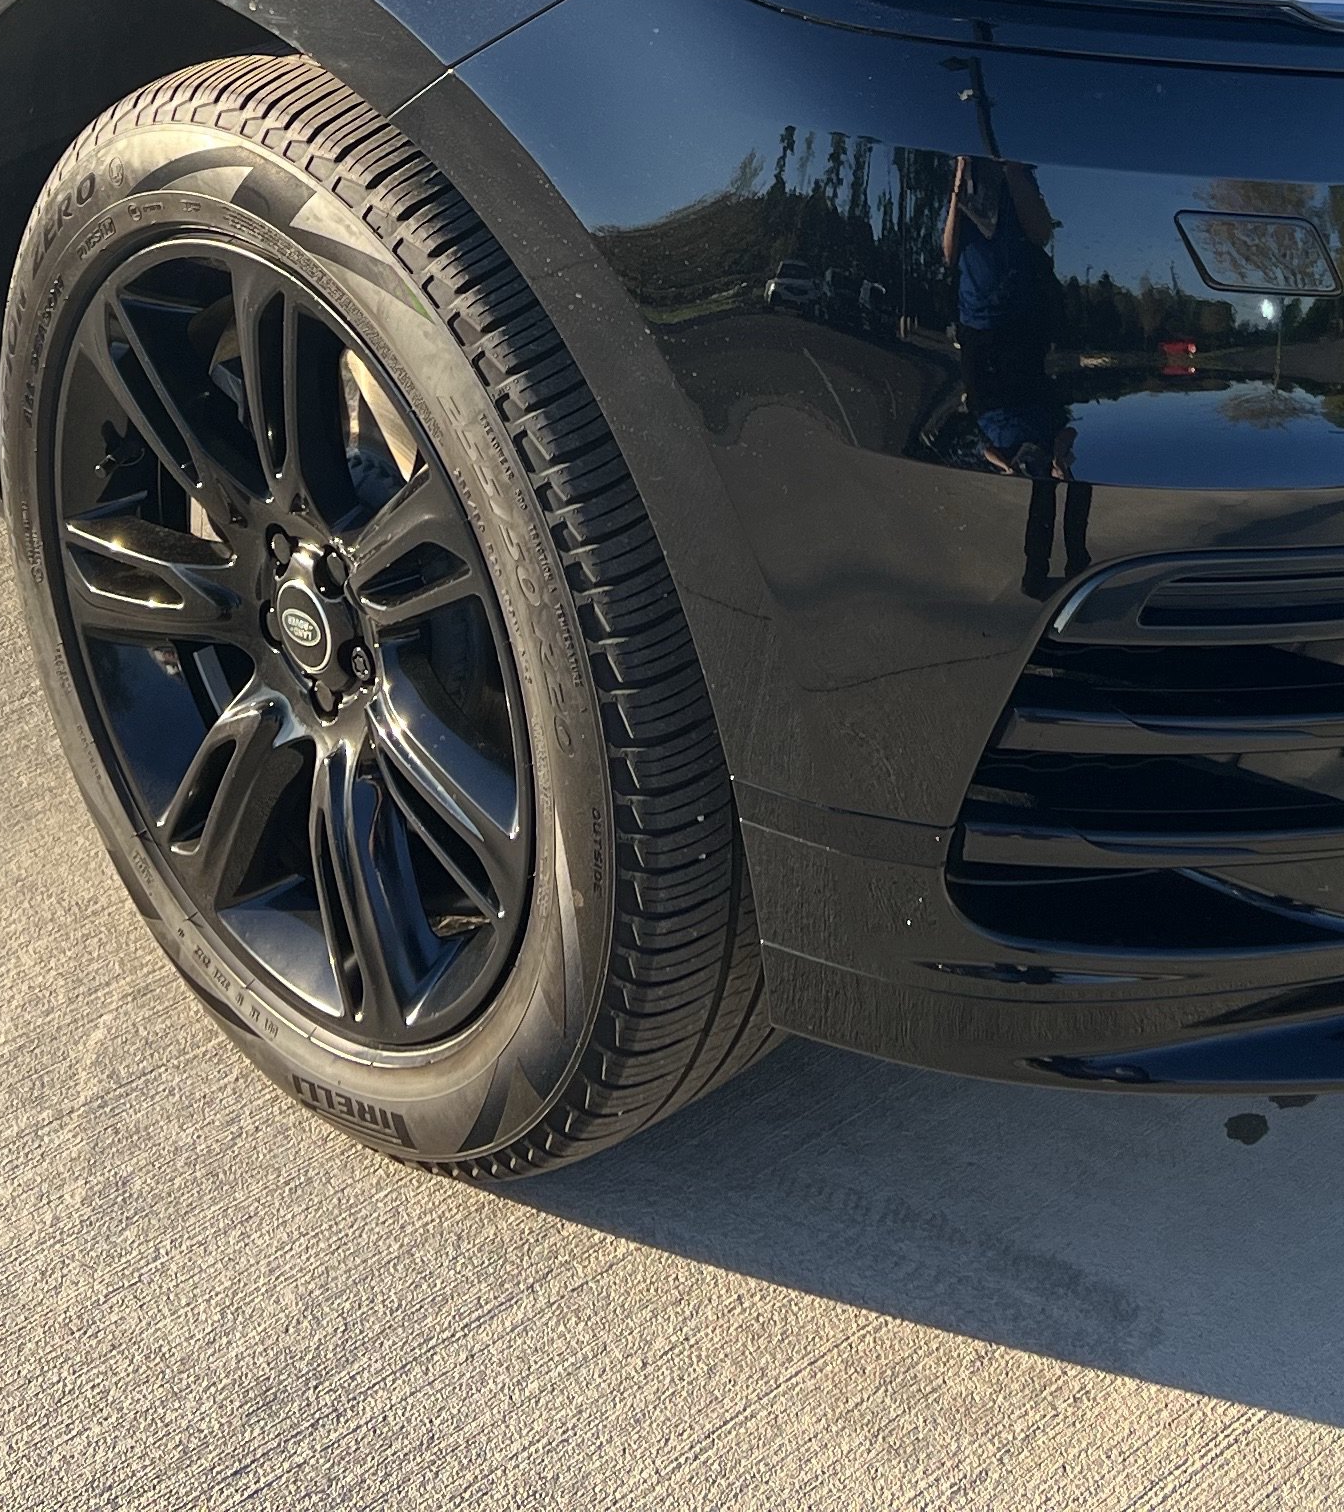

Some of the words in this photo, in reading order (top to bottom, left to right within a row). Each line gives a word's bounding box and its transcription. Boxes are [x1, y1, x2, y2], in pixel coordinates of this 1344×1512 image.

[32, 172, 96, 280] ZERO
[528, 522, 555, 582] TRACTION
[554, 600, 585, 689] TEMPERATURE
[591, 806, 604, 899] OUTSIDE
[291, 1073, 418, 1151] PIRELLI
